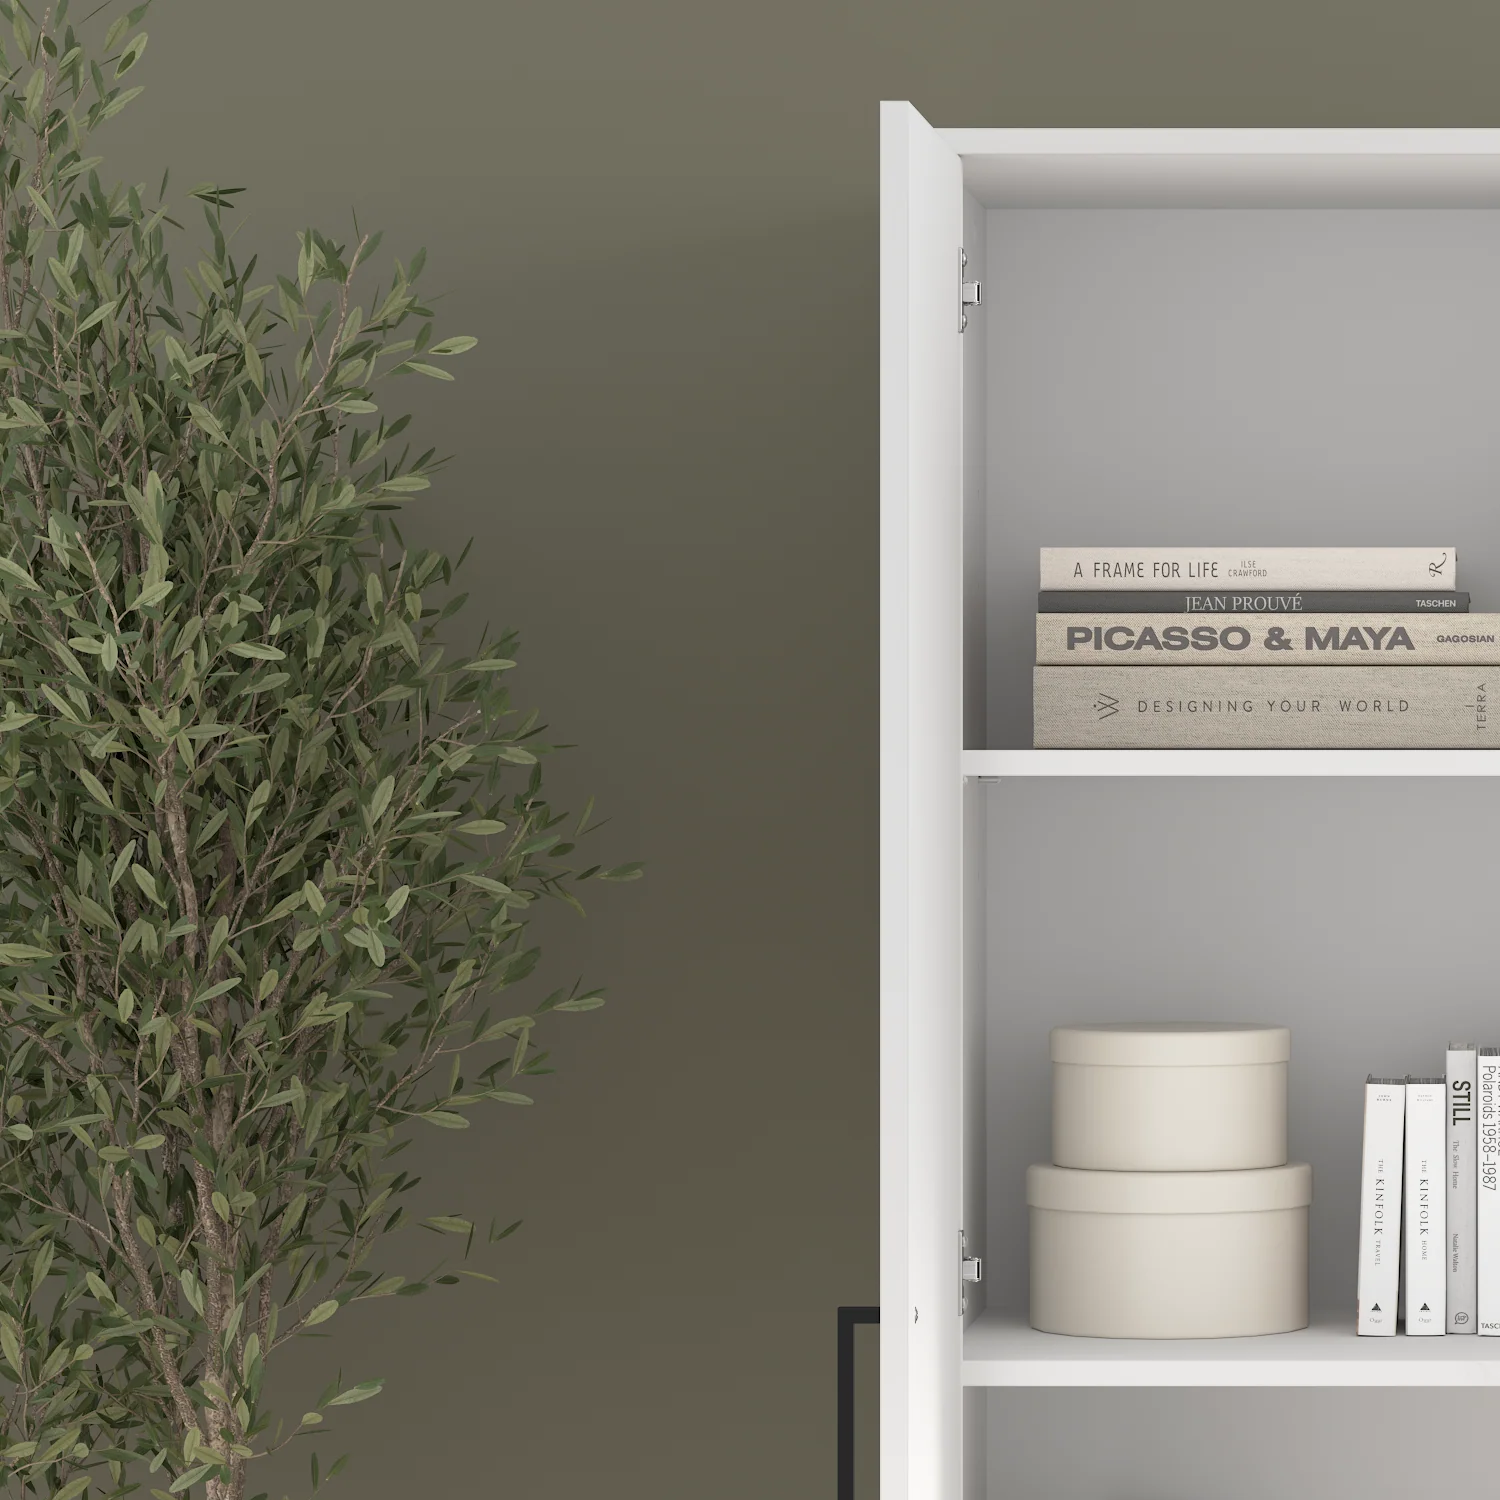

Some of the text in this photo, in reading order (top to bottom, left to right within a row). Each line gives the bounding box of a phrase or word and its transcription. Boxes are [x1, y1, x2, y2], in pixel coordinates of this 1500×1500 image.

[1073, 562, 1219, 579] A FRAME FOR LIFE
[1228, 569, 1268, 578] CRAWFORD
[1240, 560, 1257, 568] ILSE
[1184, 593, 1303, 614] JEAN PROUVÉ
[1415, 599, 1457, 608] TASCHEN
[1067, 626, 1416, 651] PICASSO & MAYA
[1436, 635, 1495, 644] GAGOSIAN
[1138, 700, 1410, 713] DESIGNING YOUR WORLD
[1476, 683, 1487, 731] TERRA
[1452, 1080, 1471, 1126] STILL
[1482, 1065, 1496, 1119] Polaroids
[1373, 1178, 1386, 1235] KINFOLK
[1419, 1178, 1429, 1235] KINFOLK
[1374, 1240, 1382, 1267] TRAVEL
